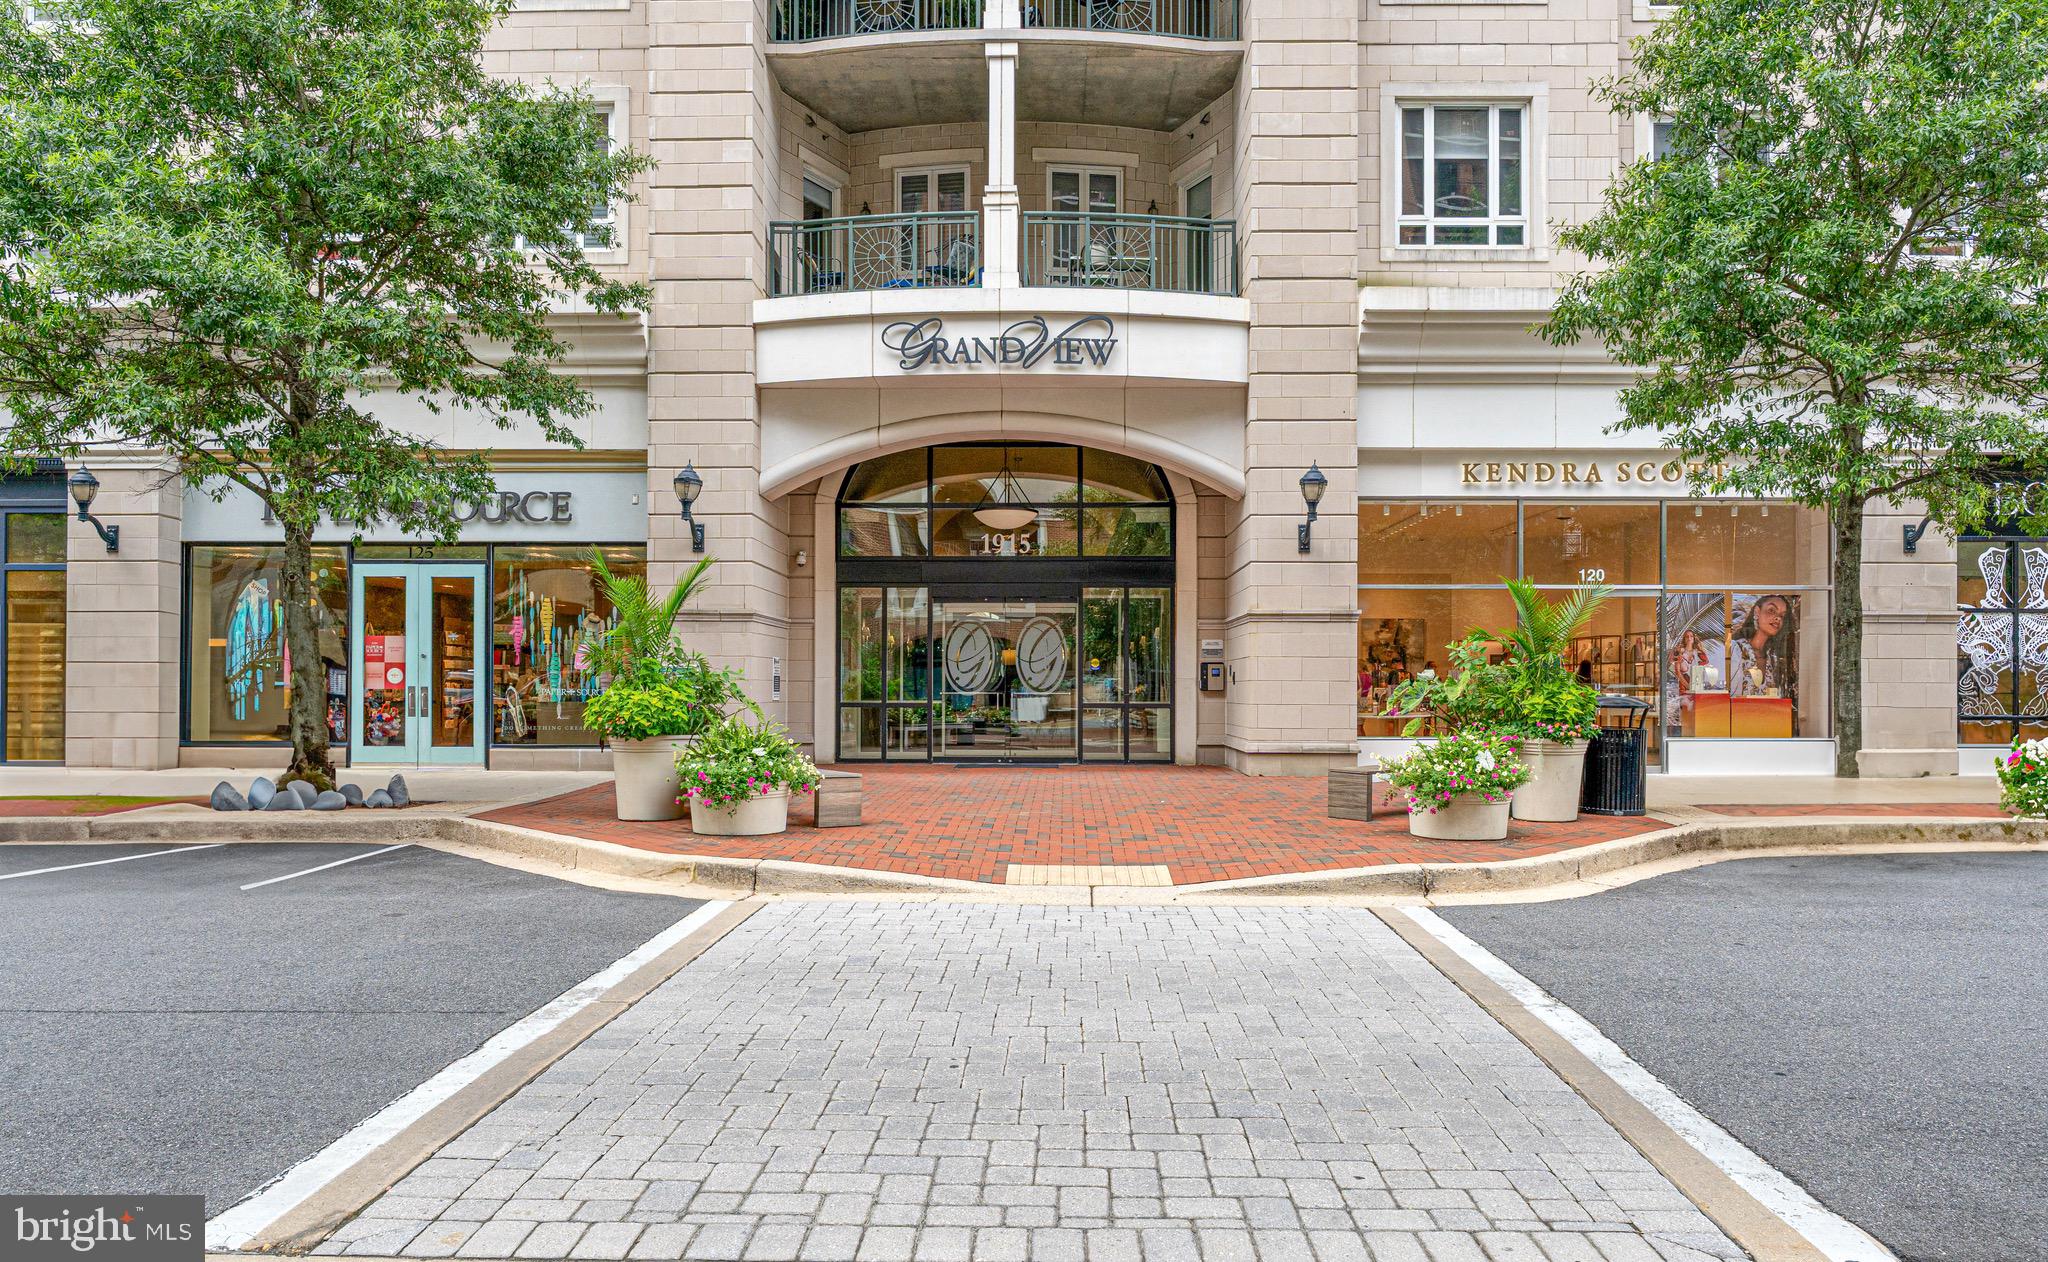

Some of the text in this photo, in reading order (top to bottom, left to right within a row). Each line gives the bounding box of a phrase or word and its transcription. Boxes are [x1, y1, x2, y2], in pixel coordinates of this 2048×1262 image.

[882, 315, 1118, 370] GRANDVIEW
[1462, 462, 1603, 483] KENDRA
[434, 490, 573, 522] OURCE
[980, 533, 1031, 554] 1915
[408, 546, 434, 559] 125
[1578, 568, 1606, 582] 120
[250, 582, 267, 595] SHOP
[576, 688, 606, 697] SOURC
